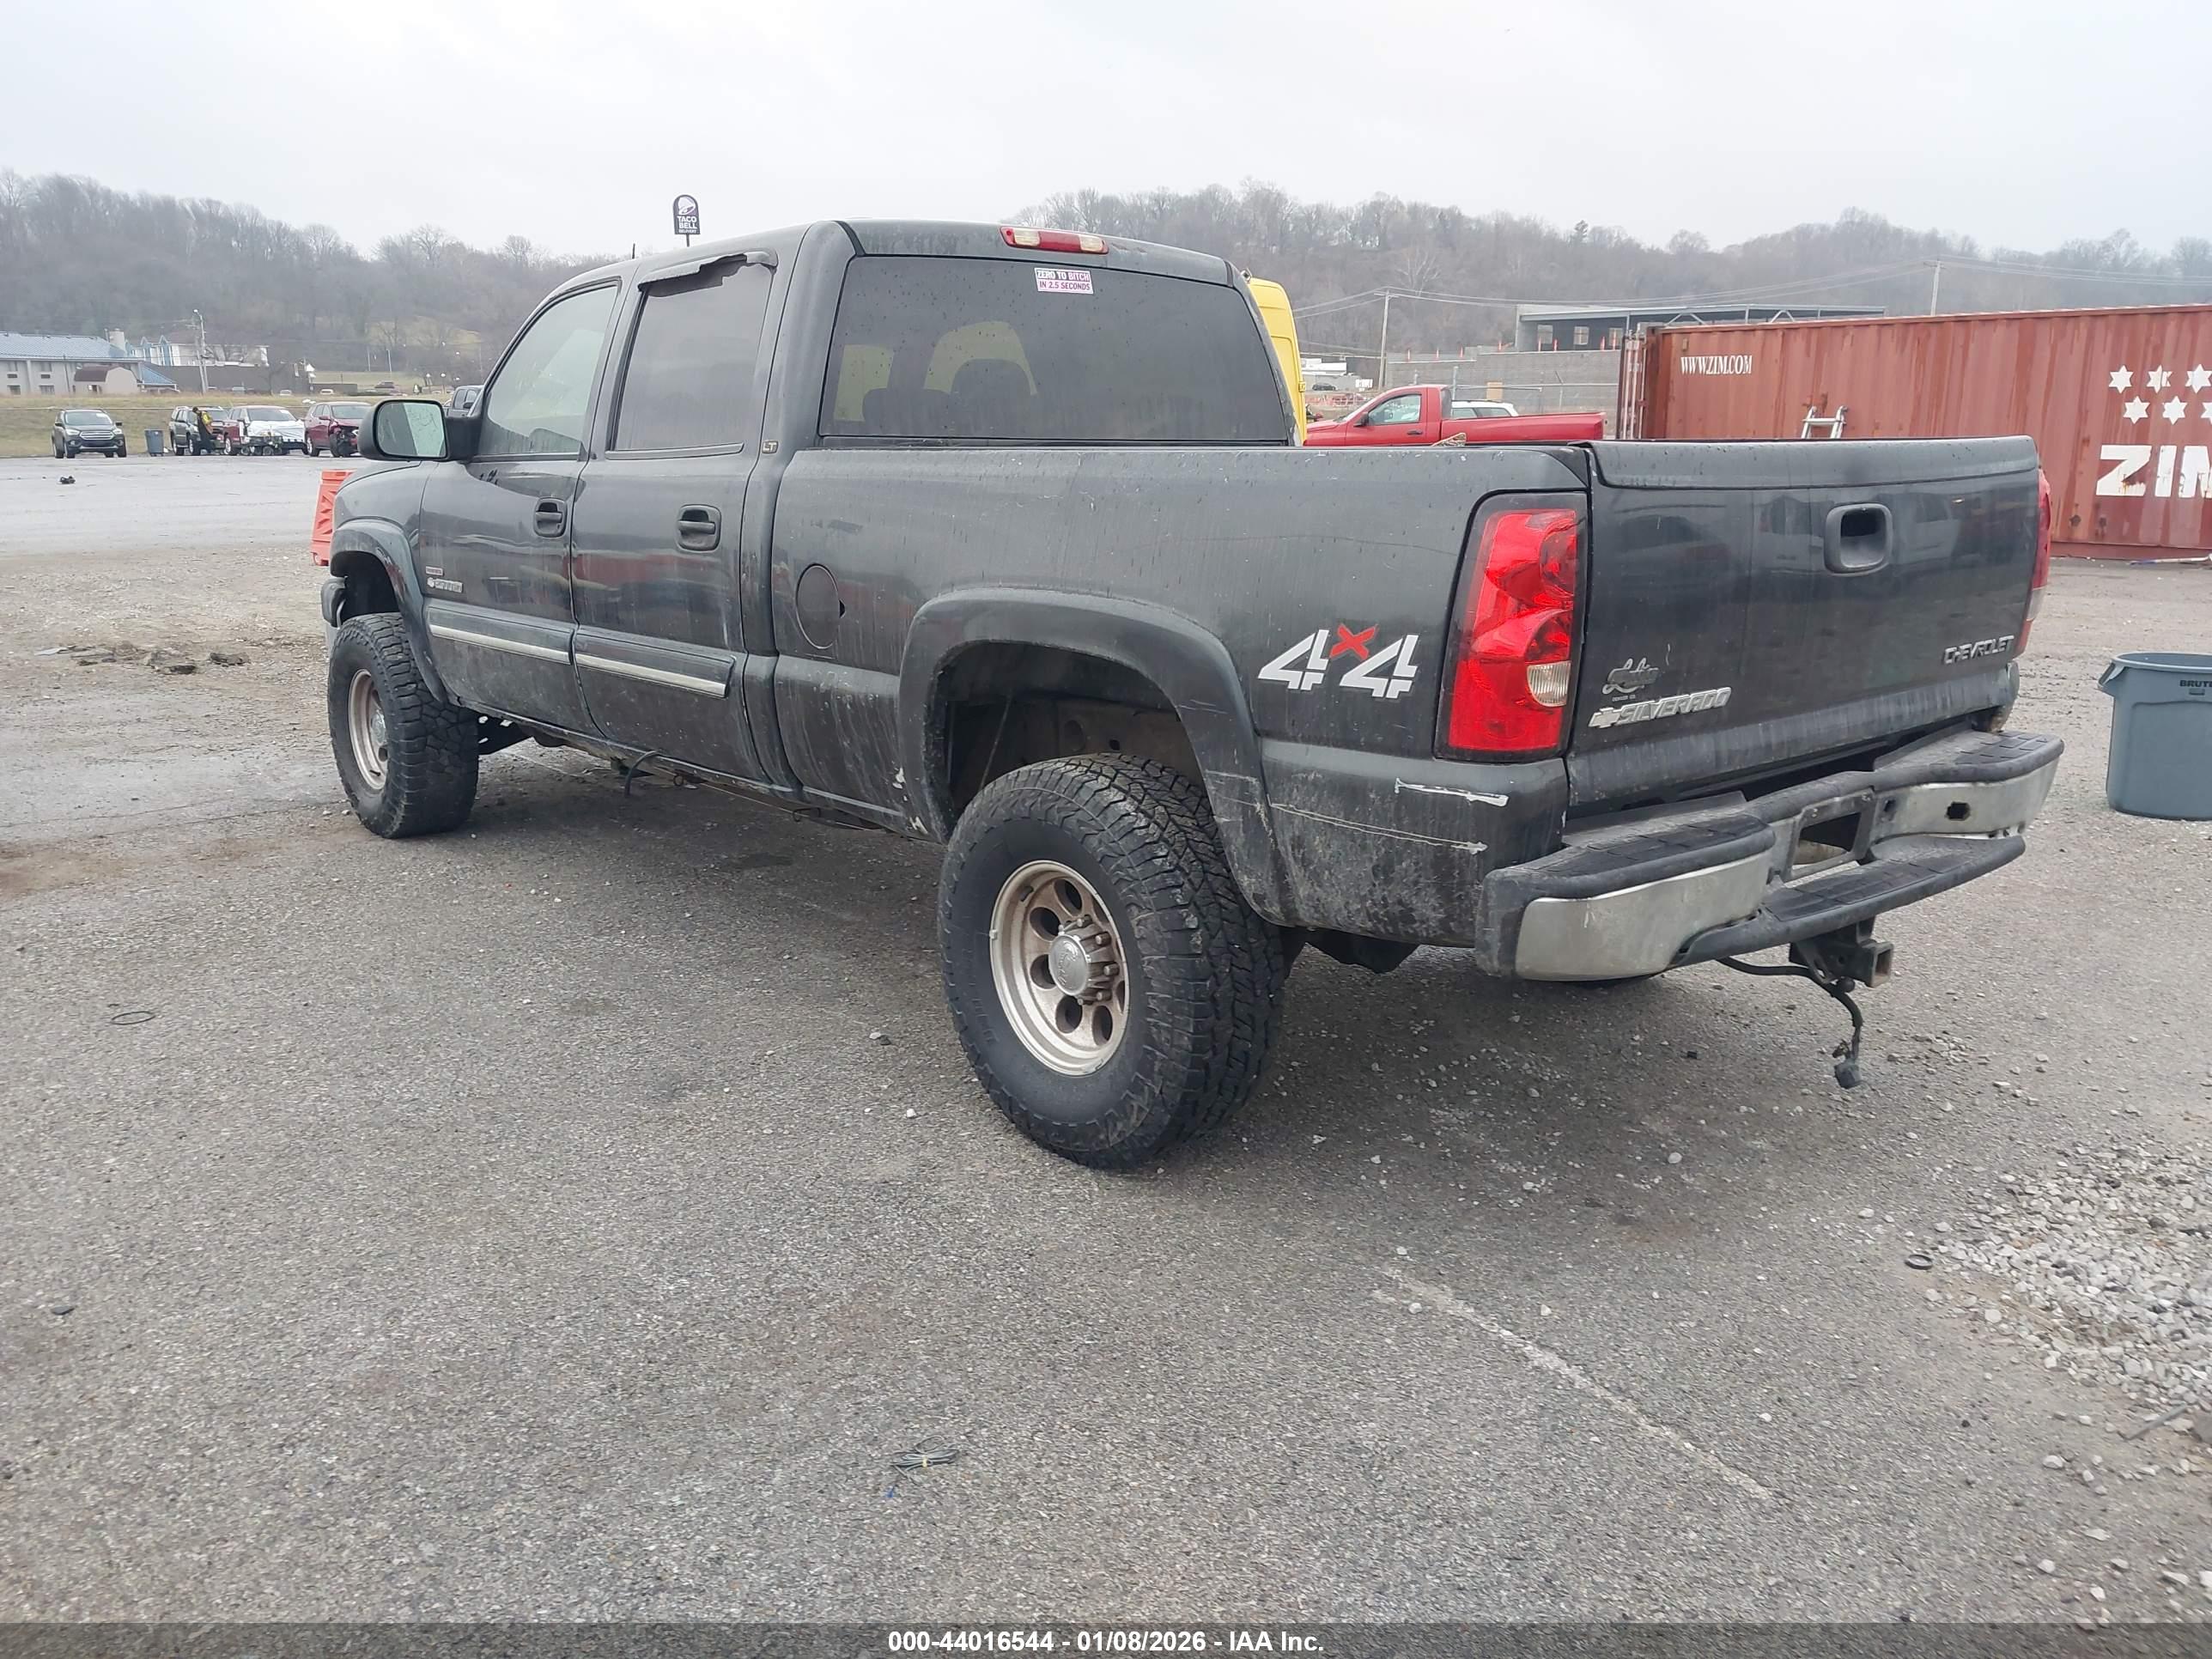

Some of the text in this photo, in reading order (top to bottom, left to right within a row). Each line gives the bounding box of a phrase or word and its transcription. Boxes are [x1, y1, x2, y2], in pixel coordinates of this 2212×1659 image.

[1036, 270, 1091, 282] ZERO TO BITCH
[1039, 280, 1091, 290] IN 2.5 SECONDS
[763, 441, 778, 453] LT
[1944, 635, 2014, 665] CHEVROLET
[1614, 686, 1732, 726] SILVERADO
